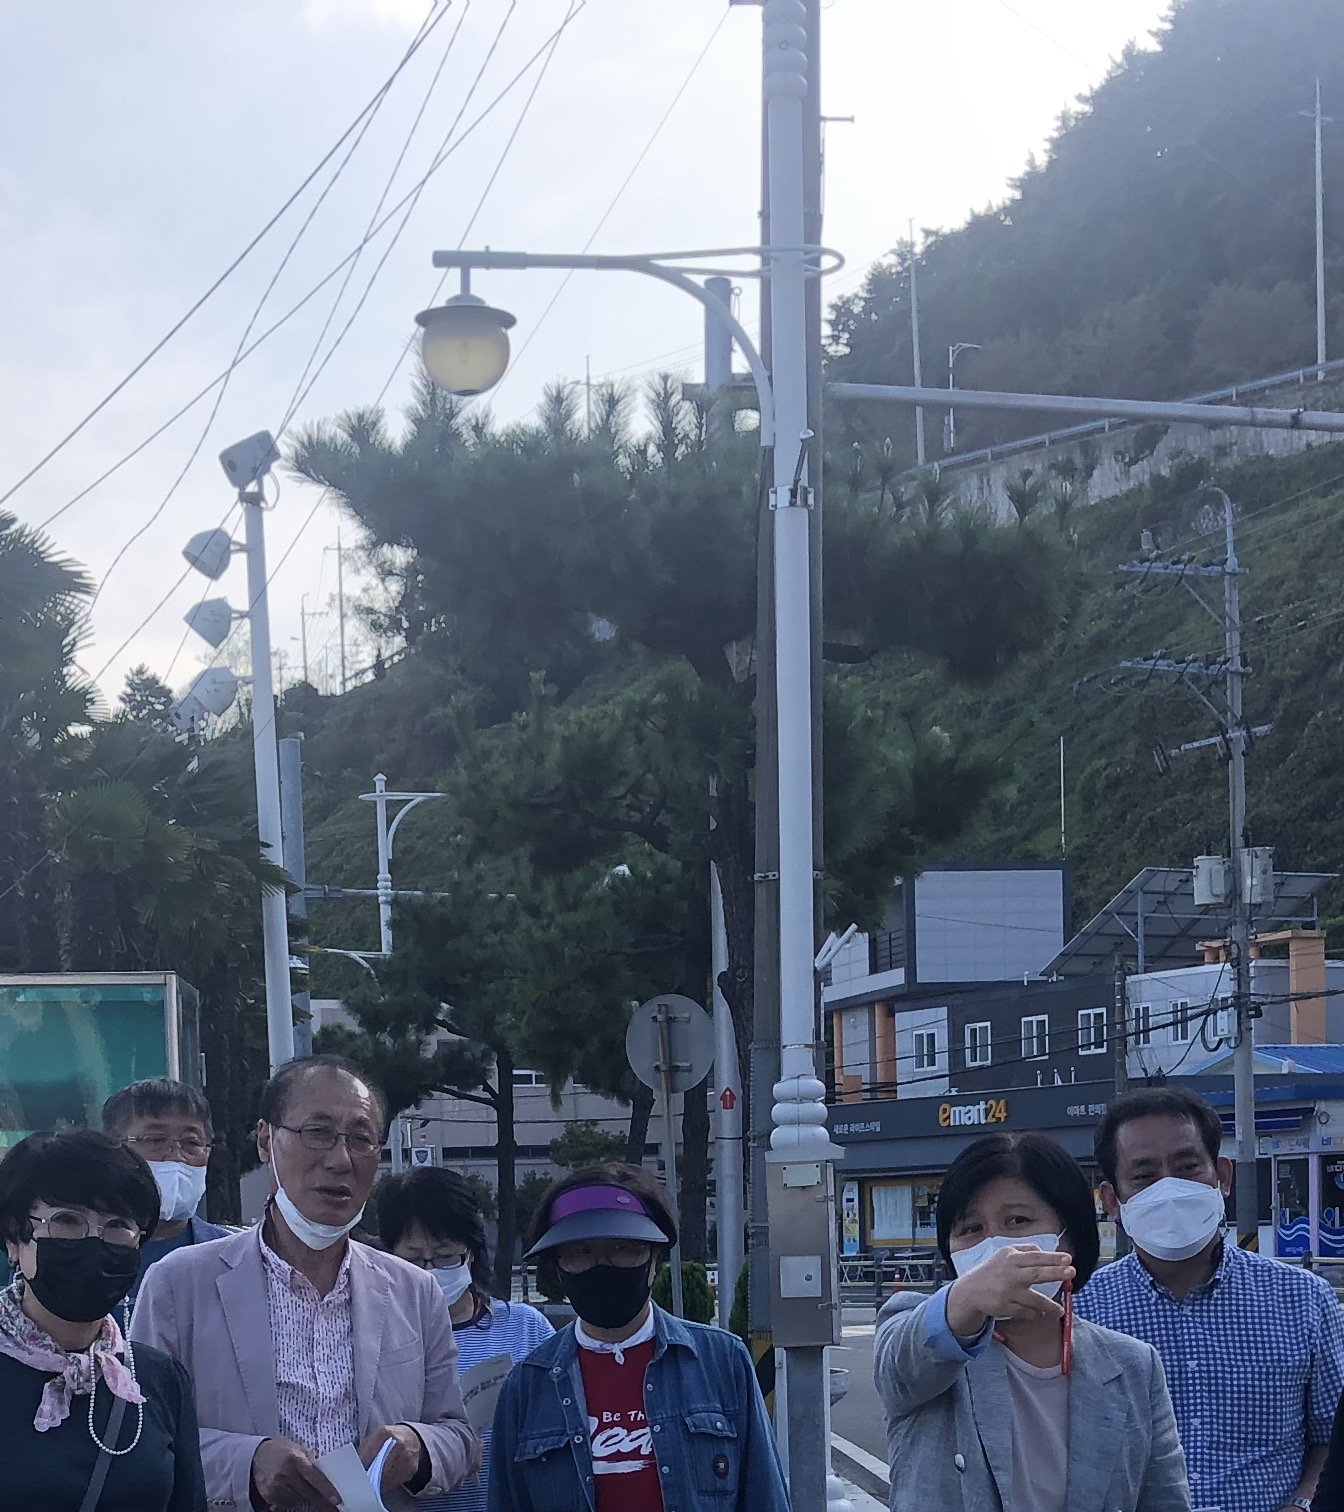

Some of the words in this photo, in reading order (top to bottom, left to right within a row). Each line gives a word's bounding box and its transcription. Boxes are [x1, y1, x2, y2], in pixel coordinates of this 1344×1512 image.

[938, 1099, 1008, 1128] emart24
[602, 1411, 621, 1423] Be
[627, 1410, 645, 1422] Th
